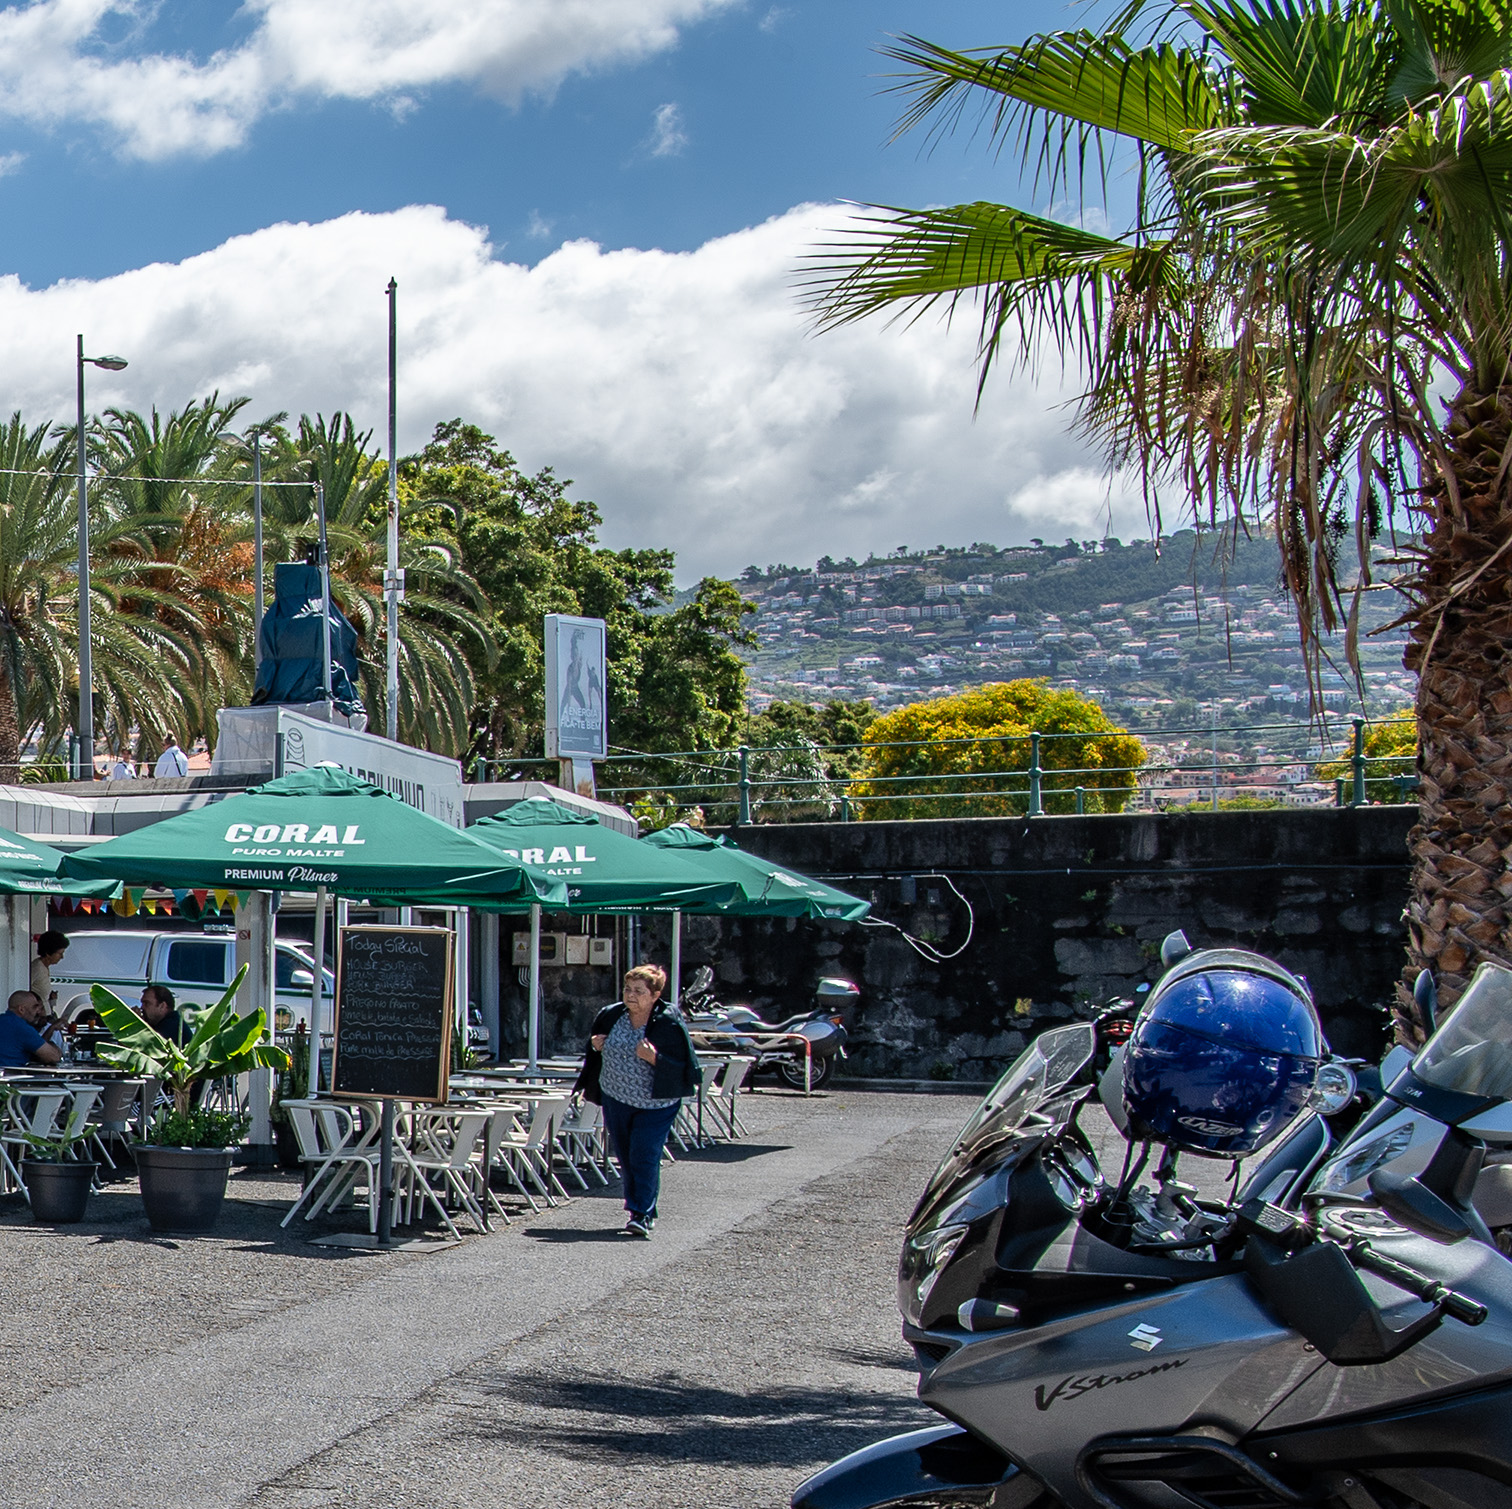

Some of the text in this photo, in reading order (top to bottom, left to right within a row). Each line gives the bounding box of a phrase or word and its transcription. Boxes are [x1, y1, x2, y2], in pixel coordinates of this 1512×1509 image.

[224, 823, 366, 845] CORAL
[232, 848, 345, 857] PURO MALTE
[224, 866, 338, 883] PREMIUM Pilsner
[346, 934, 382, 960] Today
